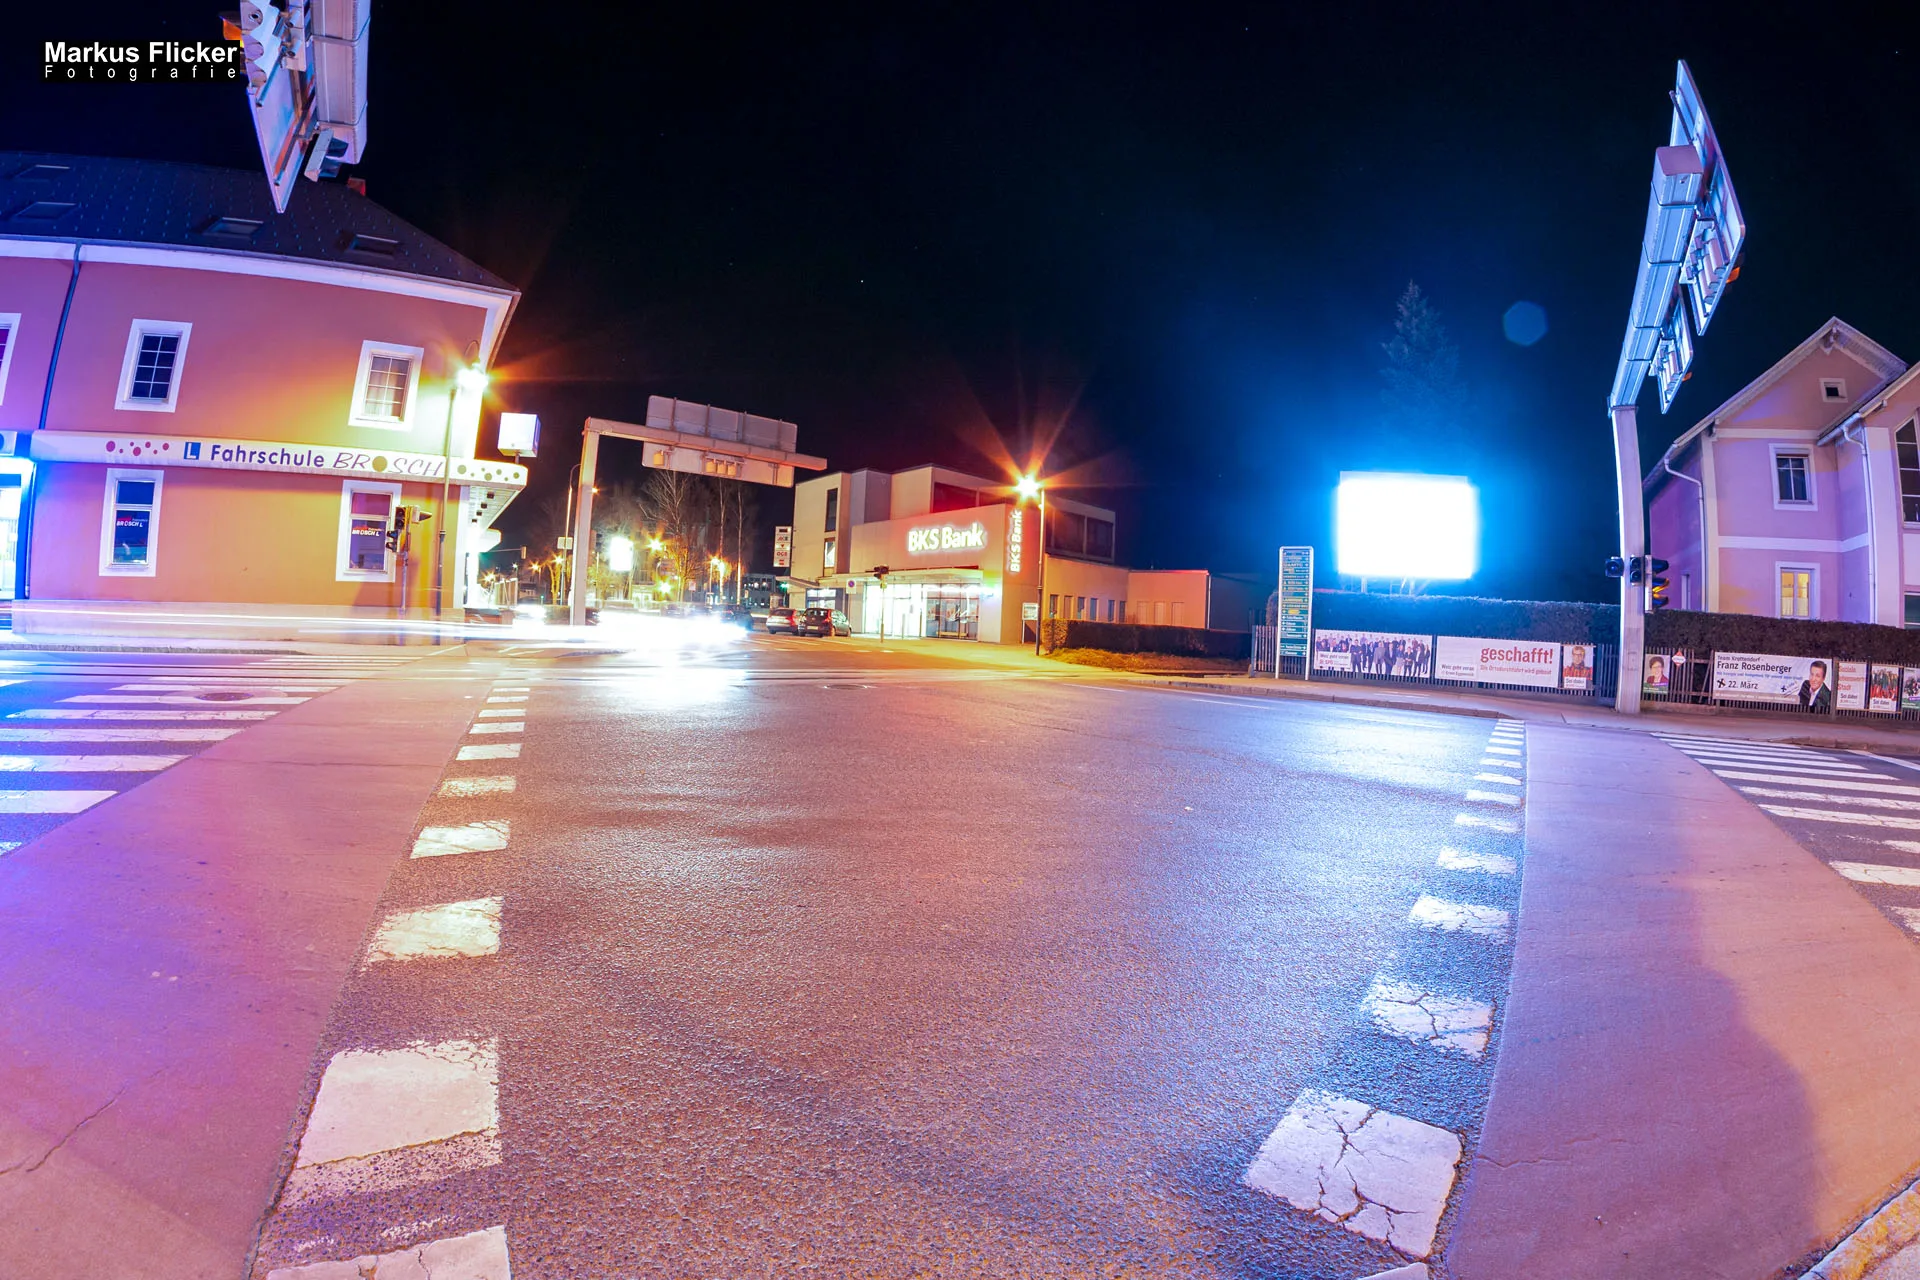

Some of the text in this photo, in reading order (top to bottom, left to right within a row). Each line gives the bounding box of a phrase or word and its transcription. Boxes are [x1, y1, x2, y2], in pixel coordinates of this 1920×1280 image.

[210, 444, 325, 468] Fahrschule
[907, 522, 984, 552] BKS Bank
[1010, 508, 1023, 573] BKS Bank
[1480, 646, 1554, 664] geschafft!
[1716, 660, 1793, 675] Franz Rosenberger
[1728, 680, 1759, 690] 22. März
